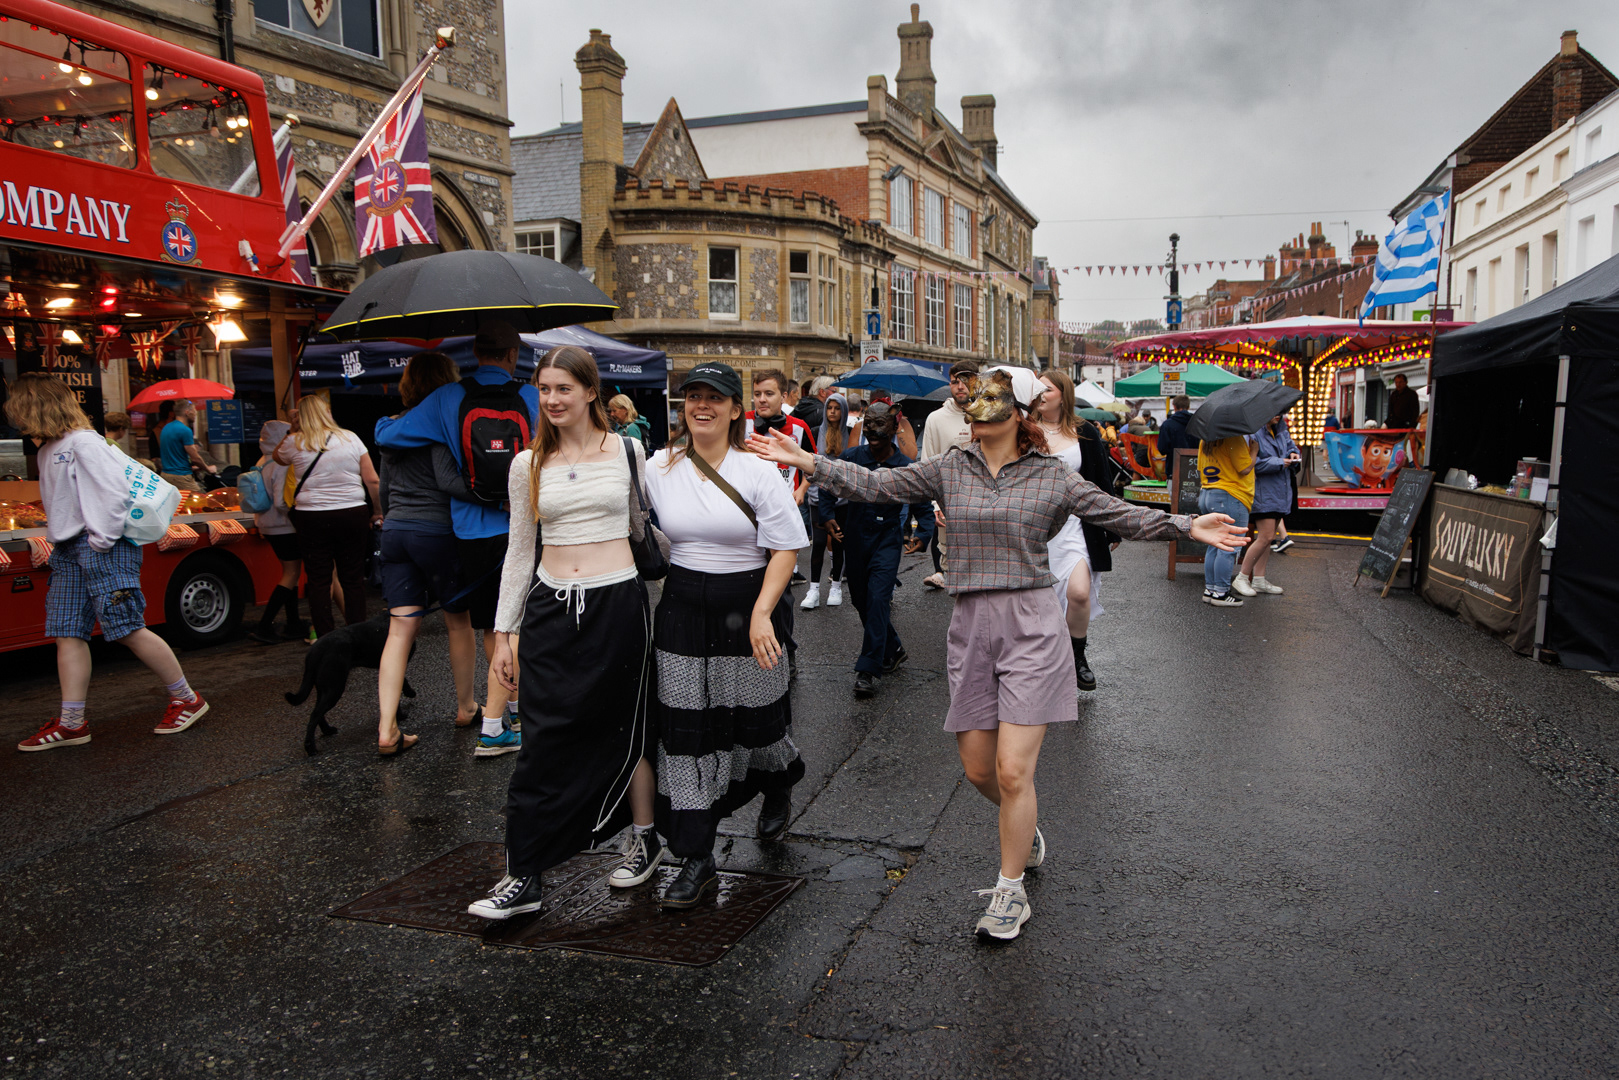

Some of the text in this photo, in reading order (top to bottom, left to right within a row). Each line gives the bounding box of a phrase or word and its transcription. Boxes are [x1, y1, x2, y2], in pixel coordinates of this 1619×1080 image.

[464, 172, 498, 185] HIGH STREET
[0, 180, 131, 242] MPANY
[40, 354, 81, 368] 10%
[341, 351, 360, 365] HAT
[343, 363, 362, 376] FAIR
[609, 363, 642, 374] PLAYMAKERS
[1431, 511, 1515, 581] SOUVLUCKY
